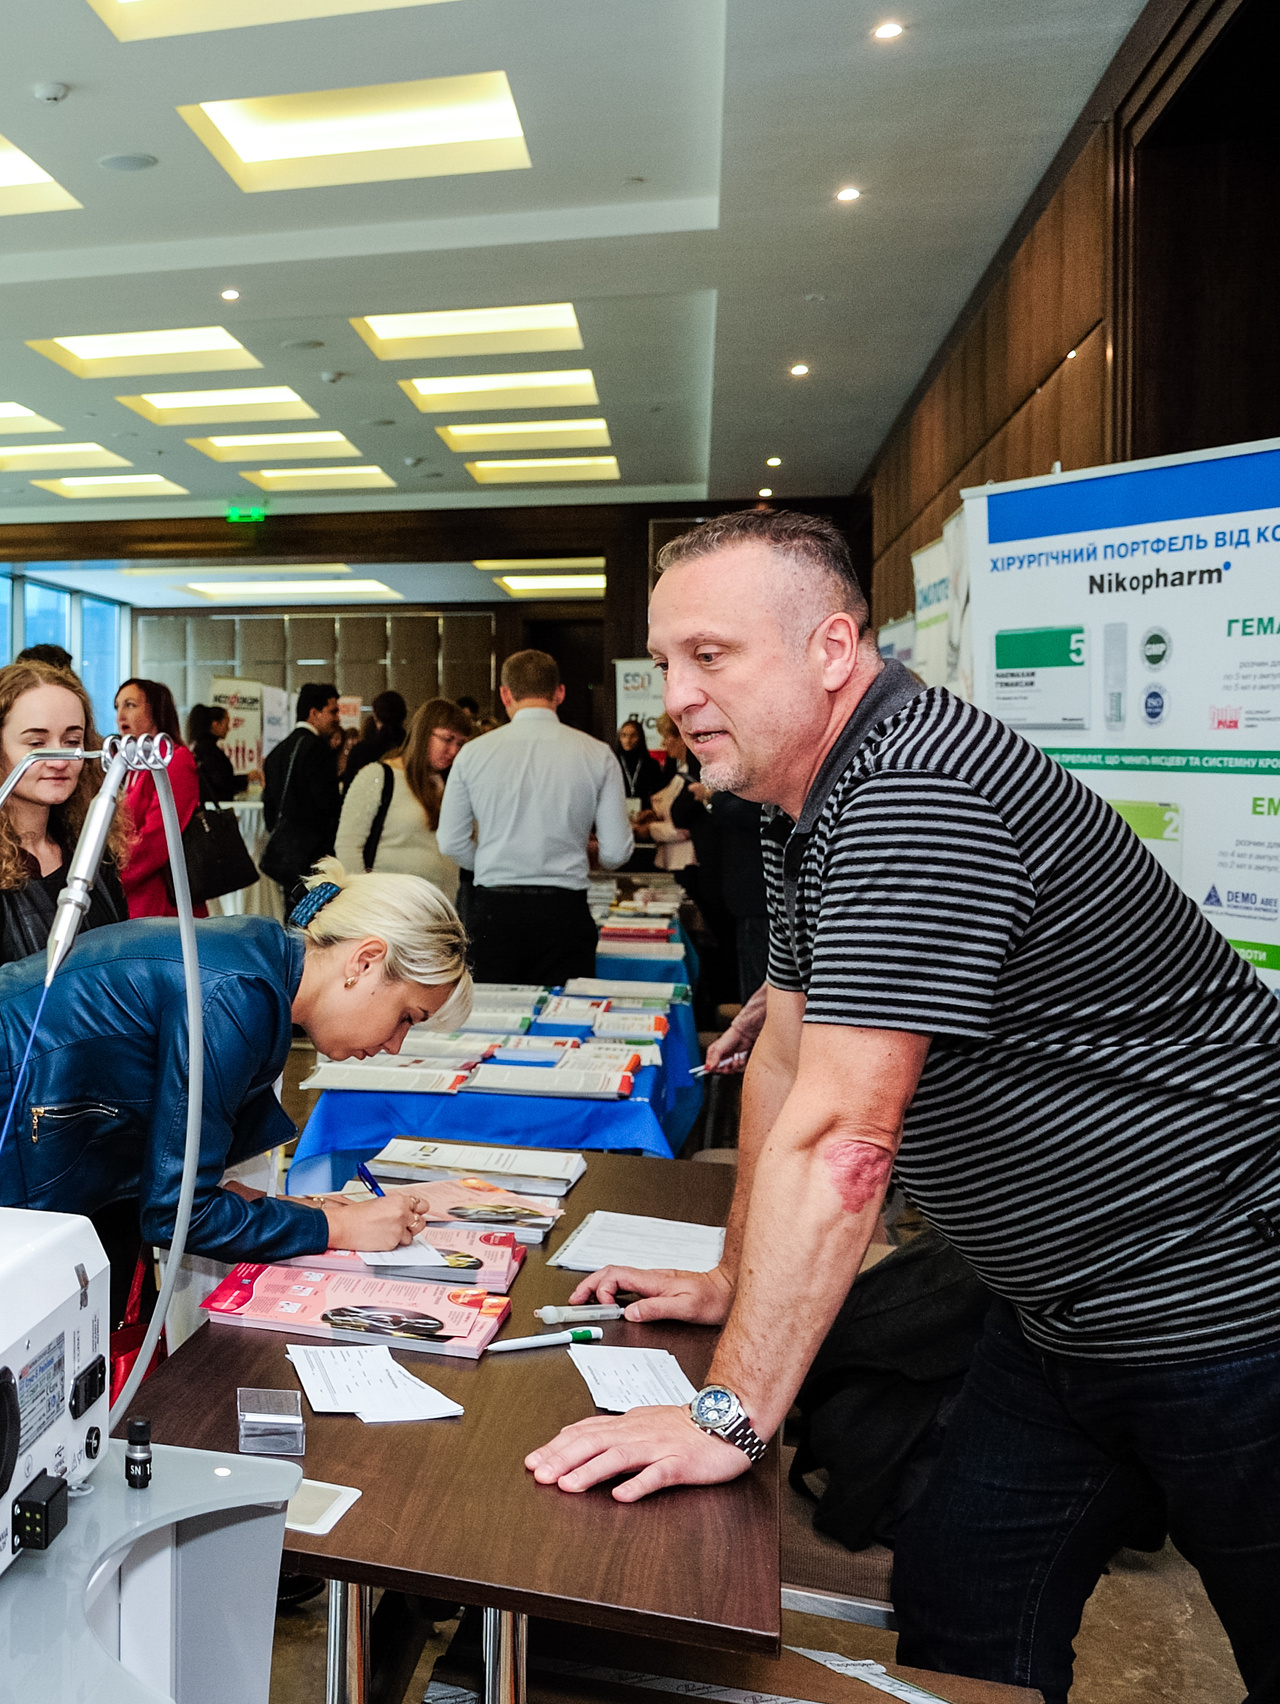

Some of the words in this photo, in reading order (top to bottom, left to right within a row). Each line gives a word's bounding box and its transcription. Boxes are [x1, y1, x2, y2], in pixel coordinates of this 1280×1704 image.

[989, 543, 1098, 573] ХІРУРГІЧНИЙ
[1103, 532, 1208, 561] ПОРТФЕЛЬ
[1214, 527, 1251, 549] ВІД
[1088, 567, 1223, 595] Nikopharm
[1070, 633, 1085, 664] 5
[1188, 756, 1201, 767] ТА
[1202, 756, 1257, 768] СИСТЕМНУ
[1162, 811, 1180, 840] 2
[1227, 890, 1258, 905] DEMO
[130, 1464, 142, 1475] SN
